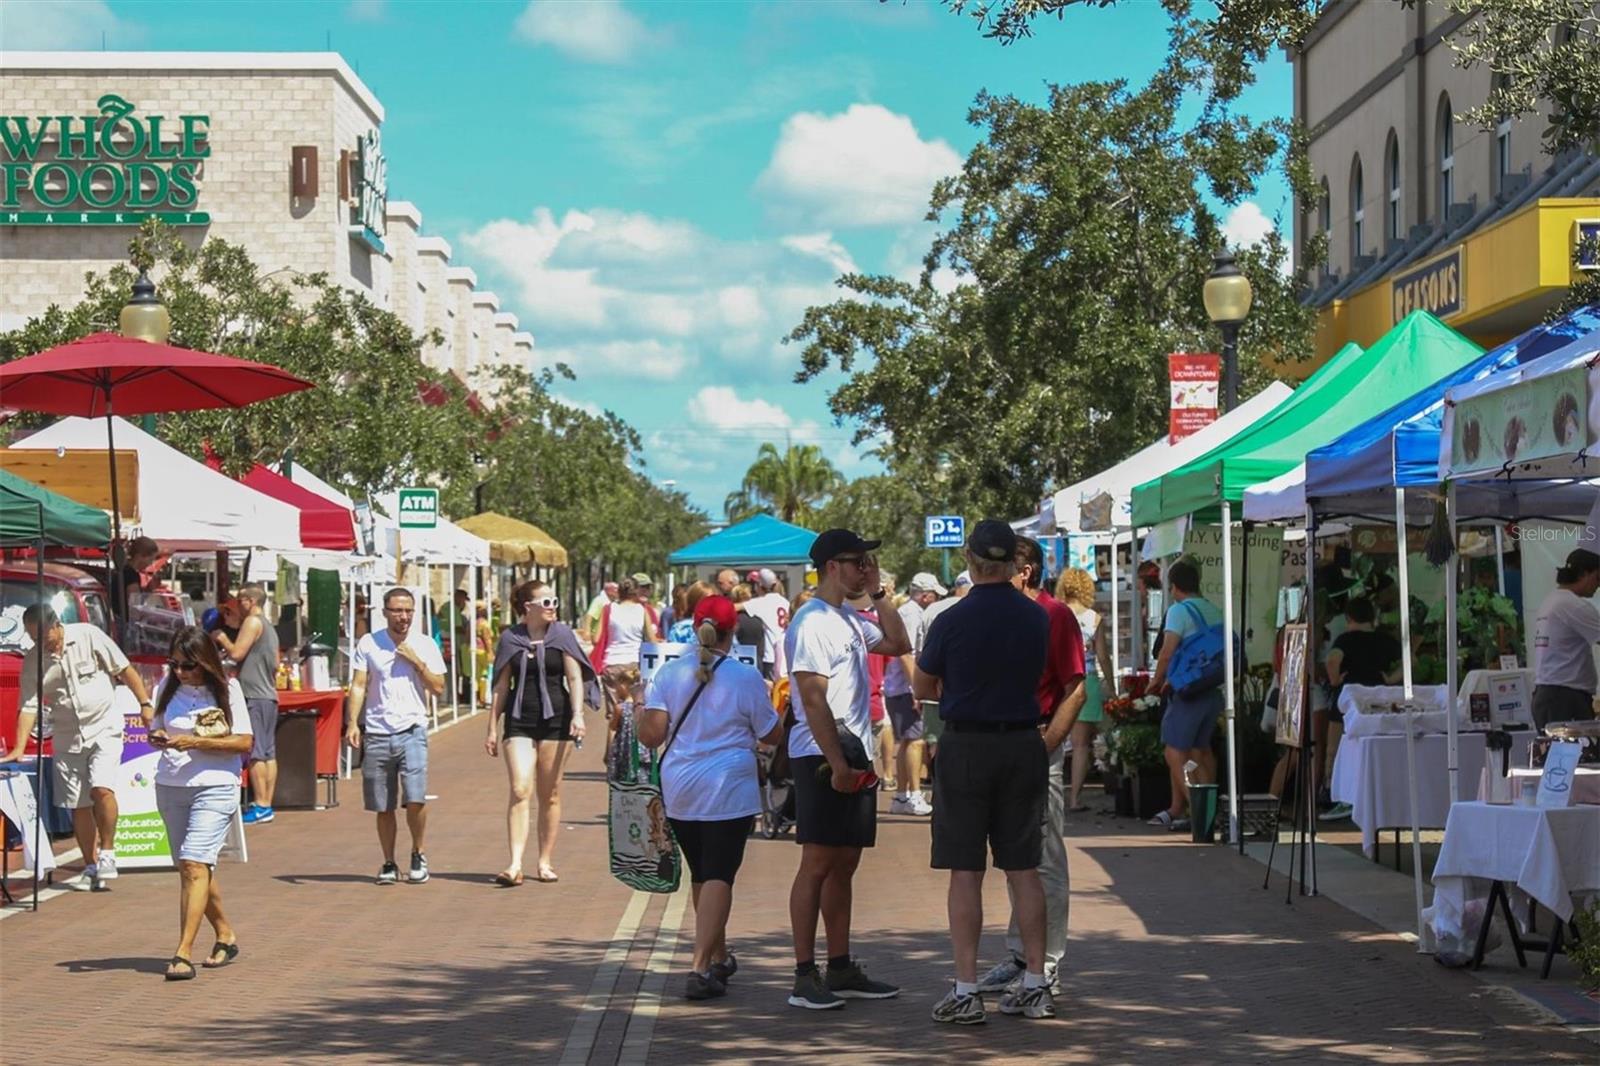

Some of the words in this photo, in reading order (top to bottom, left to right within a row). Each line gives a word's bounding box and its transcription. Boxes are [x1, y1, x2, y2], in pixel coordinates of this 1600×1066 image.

[0, 114, 211, 161] WHOLE
[0, 162, 199, 208] FOODS
[401, 495, 435, 510] ATM
[114, 831, 165, 841] Advocacy
[113, 842, 155, 853] Support
